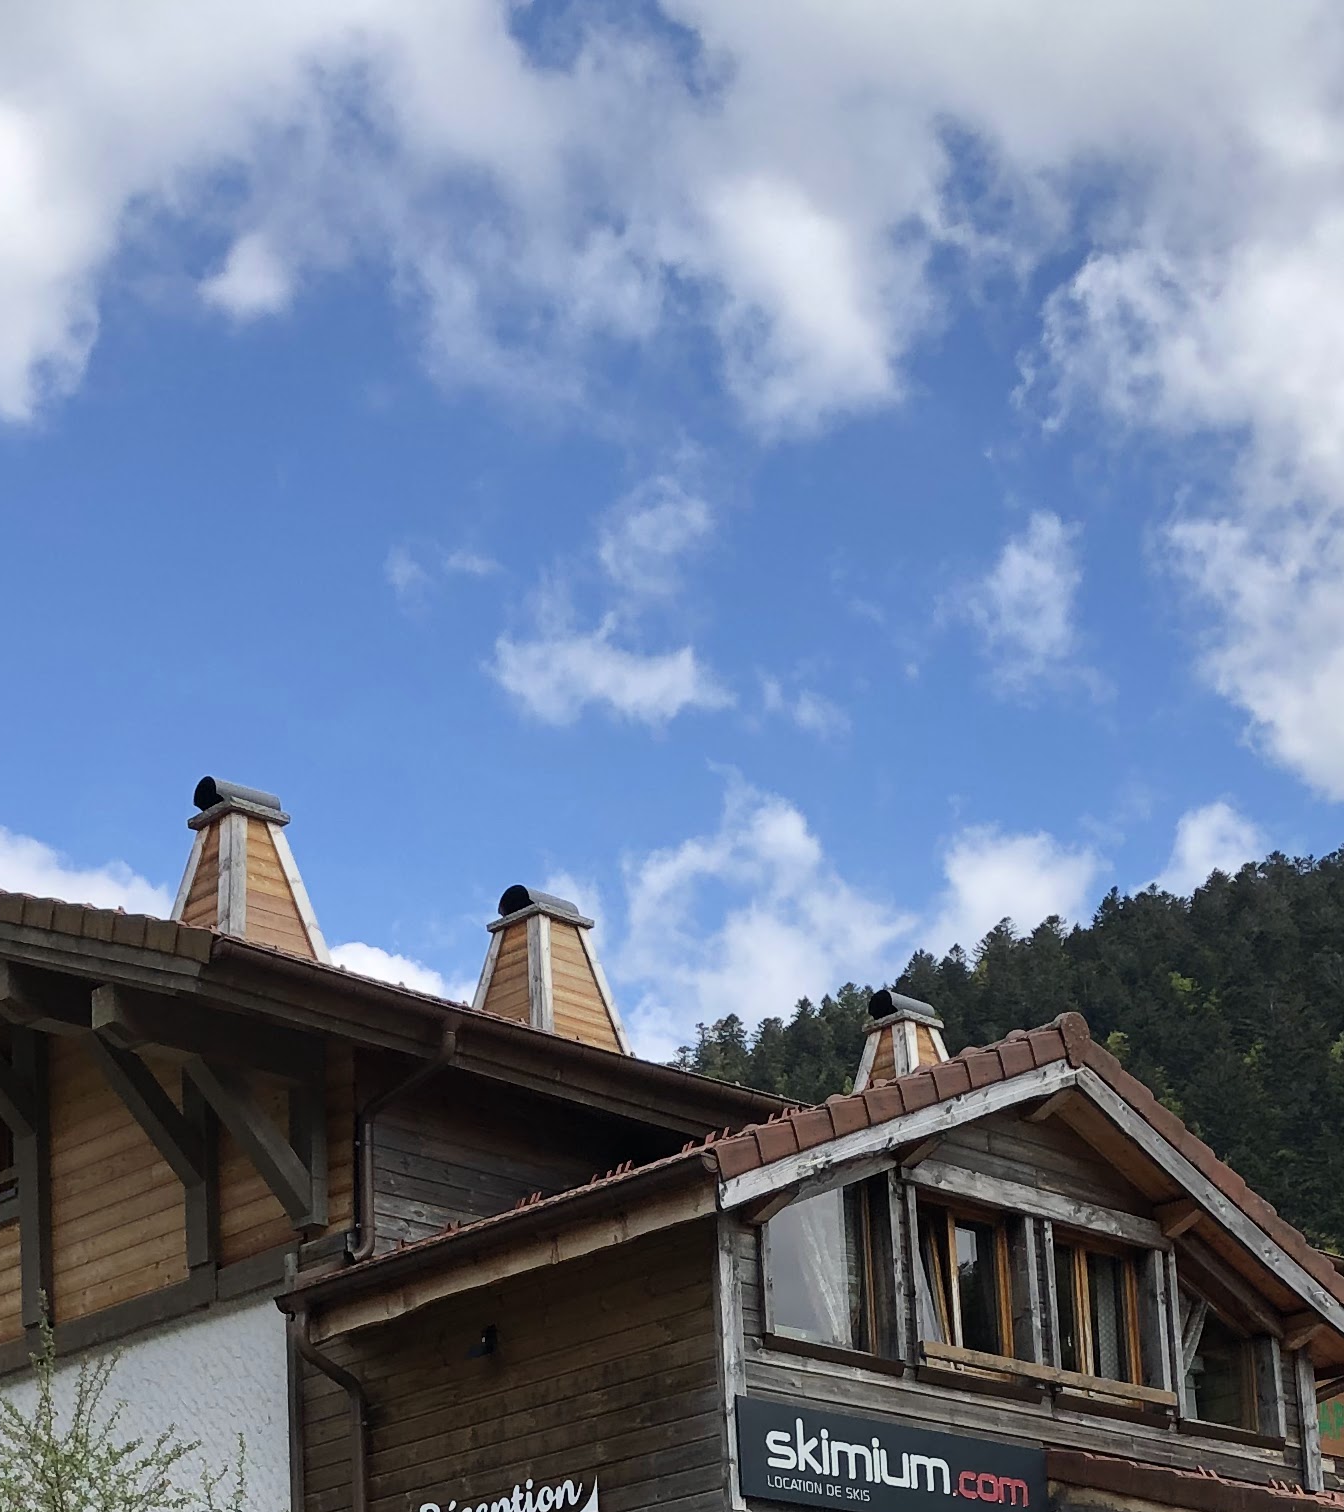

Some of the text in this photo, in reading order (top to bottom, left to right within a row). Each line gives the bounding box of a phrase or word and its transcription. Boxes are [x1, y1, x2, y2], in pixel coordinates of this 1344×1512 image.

[765, 1417, 1030, 1508] skimium.com
[767, 1474, 871, 1502] LOCATION DE SKIS
